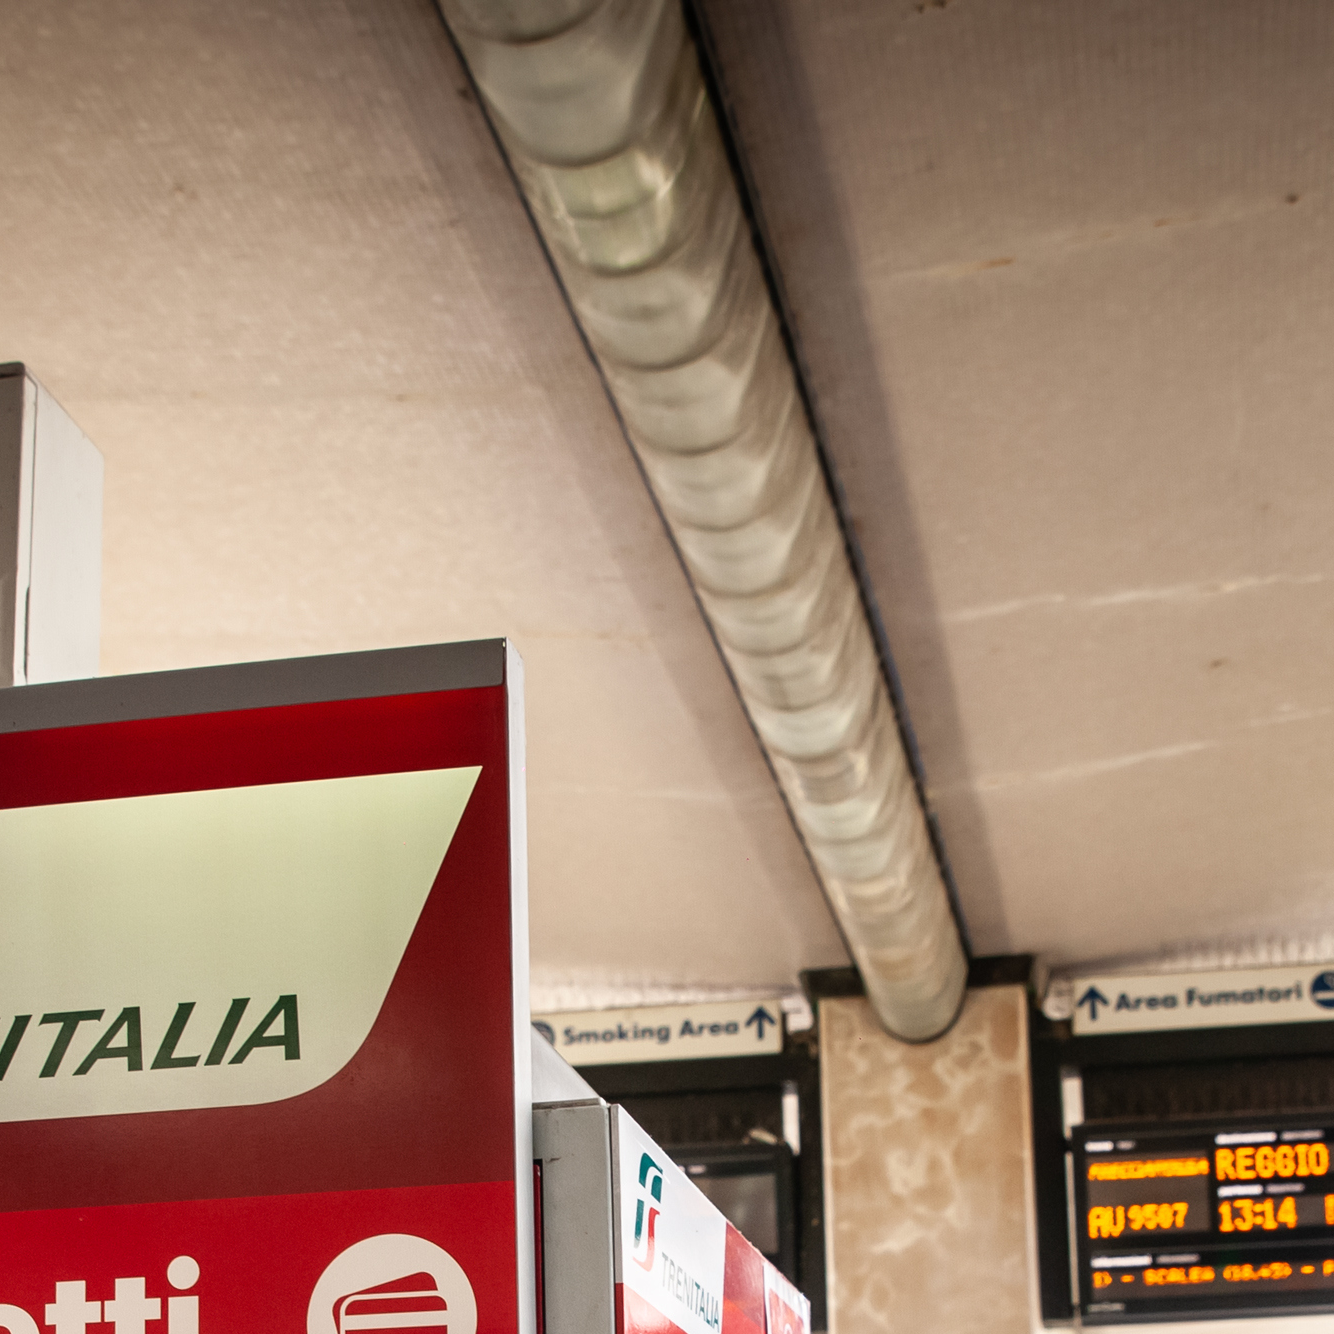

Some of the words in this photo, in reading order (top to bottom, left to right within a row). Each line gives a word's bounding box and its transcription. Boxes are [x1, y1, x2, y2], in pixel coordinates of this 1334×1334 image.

[1115, 992, 1178, 1014] Area
[1185, 983, 1302, 1009] Fumatori
[563, 1022, 671, 1045] Smoking
[679, 1019, 740, 1038] Area
[1215, 1143, 1330, 1181] REGGIO
[1217, 1196, 1298, 1233] 13:14
[661, 1251, 720, 1334] TRENITALIA
